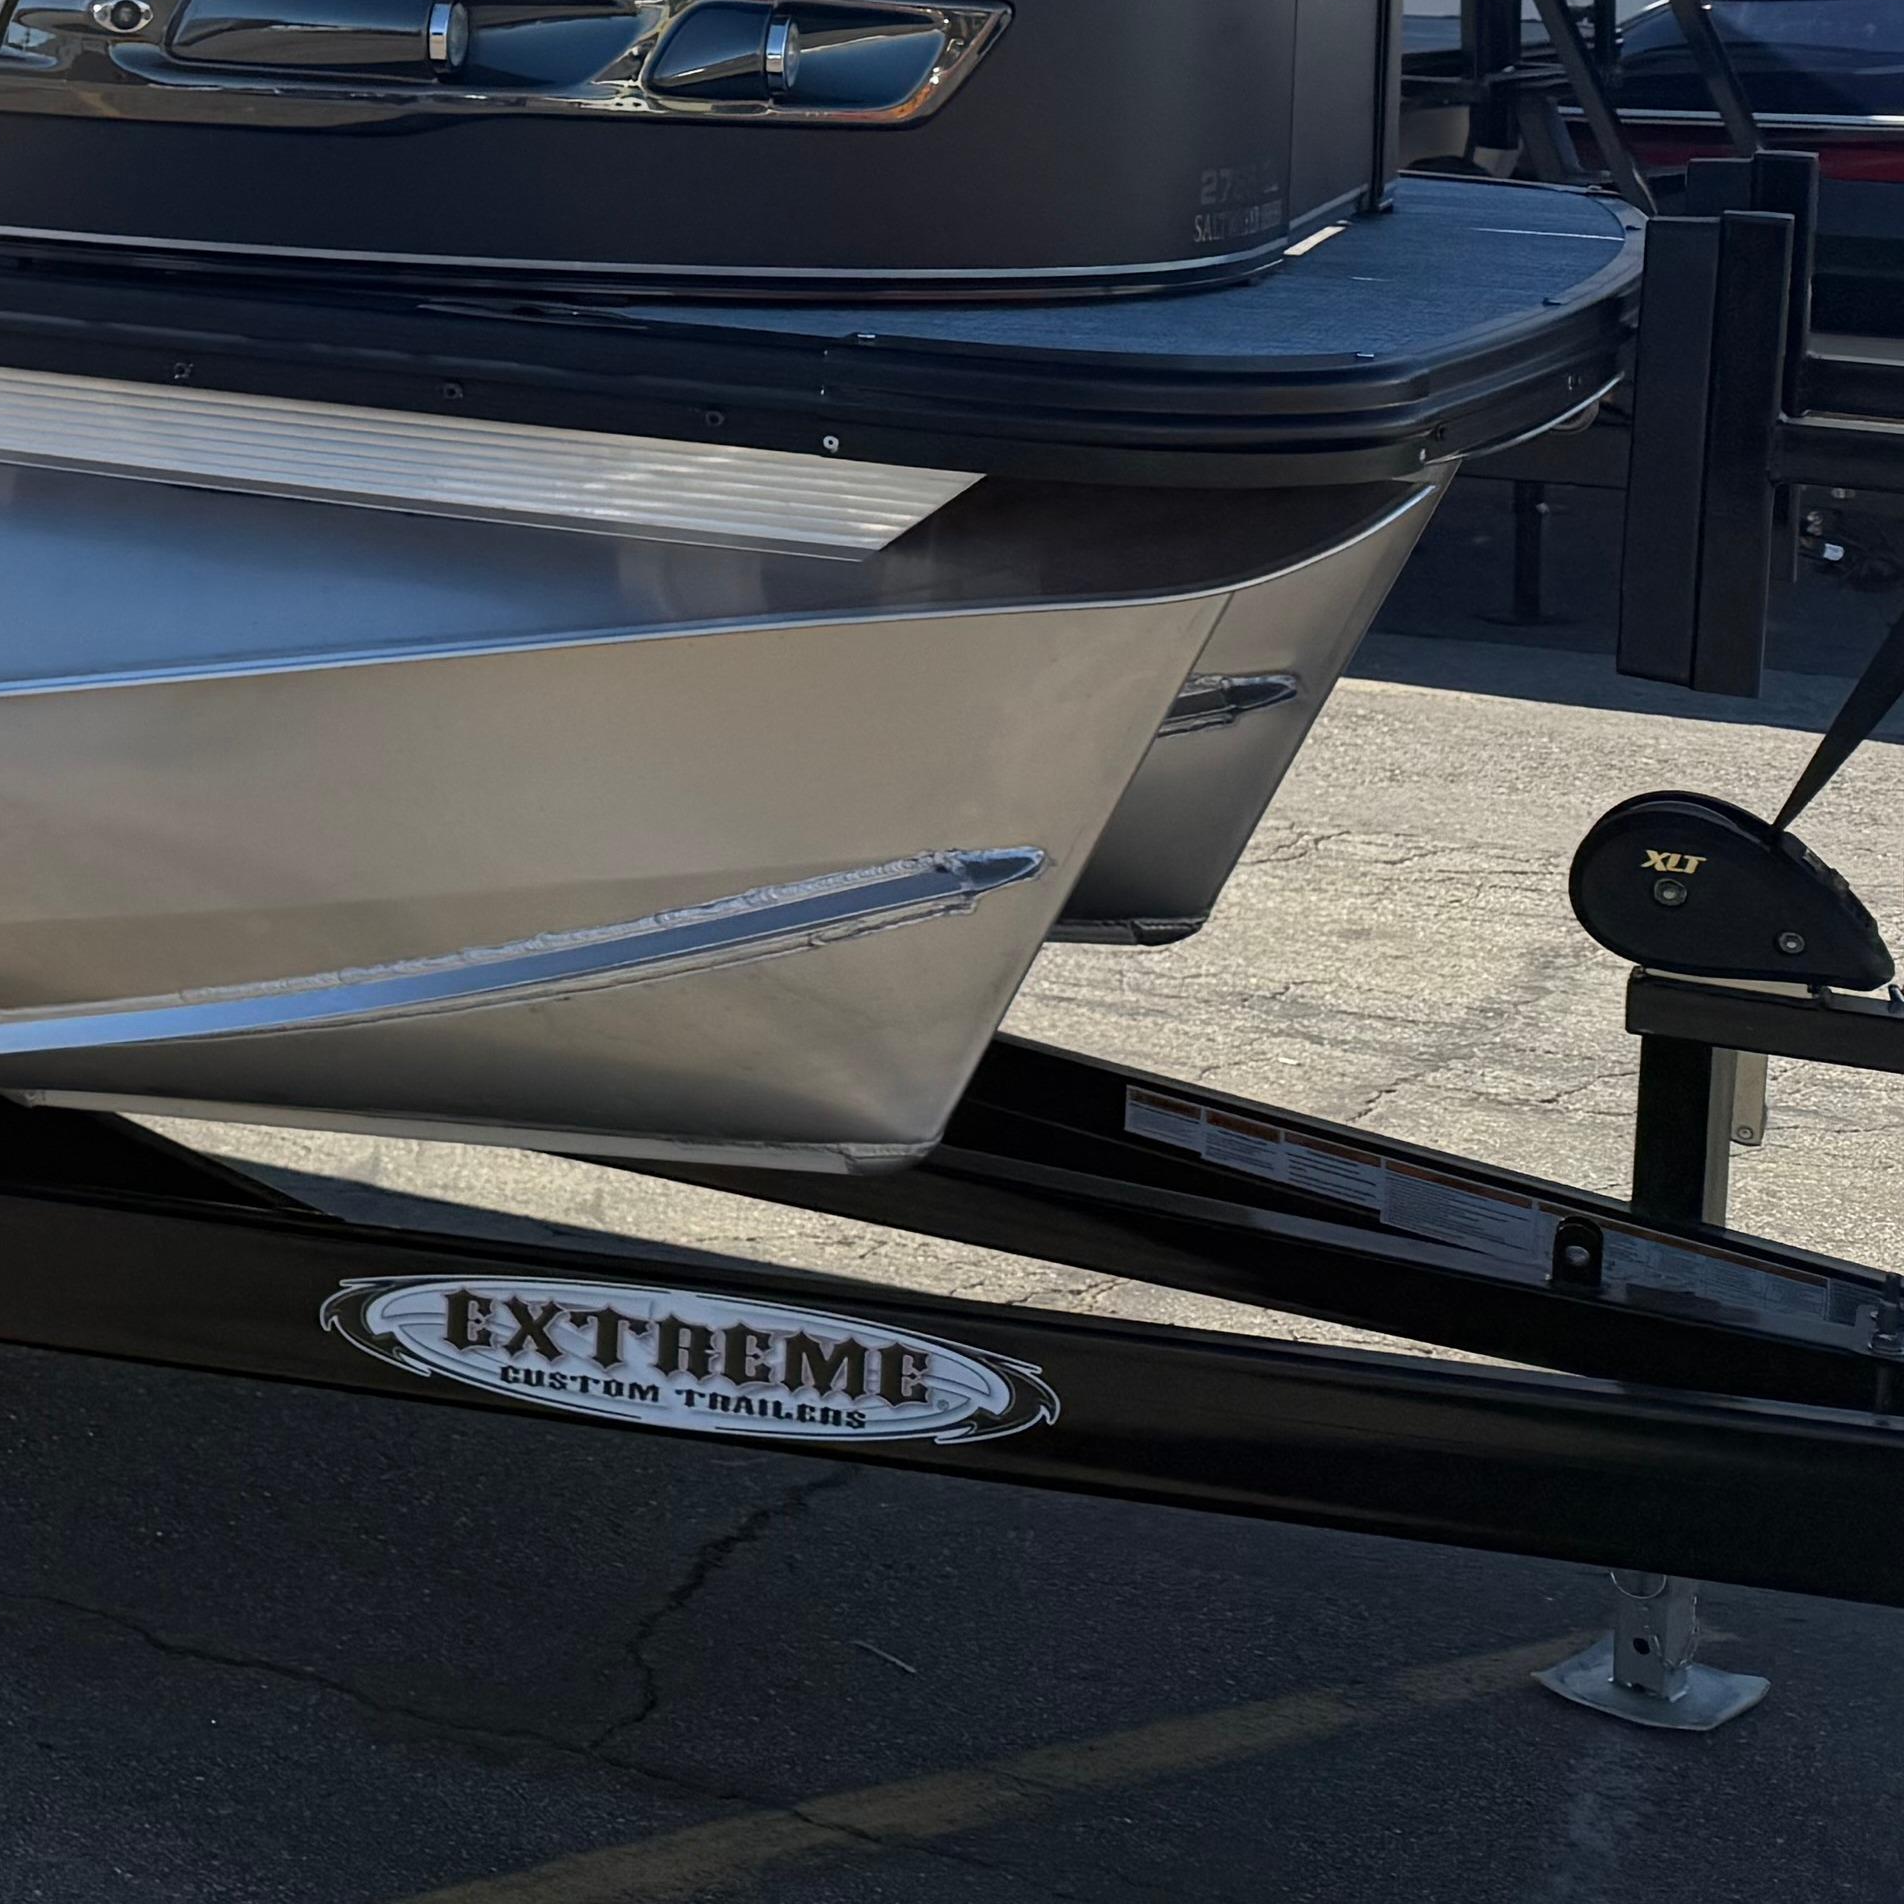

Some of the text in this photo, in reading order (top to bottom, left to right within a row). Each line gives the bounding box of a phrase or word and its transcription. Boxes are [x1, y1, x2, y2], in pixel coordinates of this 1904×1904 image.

[1640, 849, 1707, 874] XLT
[441, 1290, 932, 1406] EXTREME
[499, 1364, 867, 1429] CUSTOM TRAILERS
